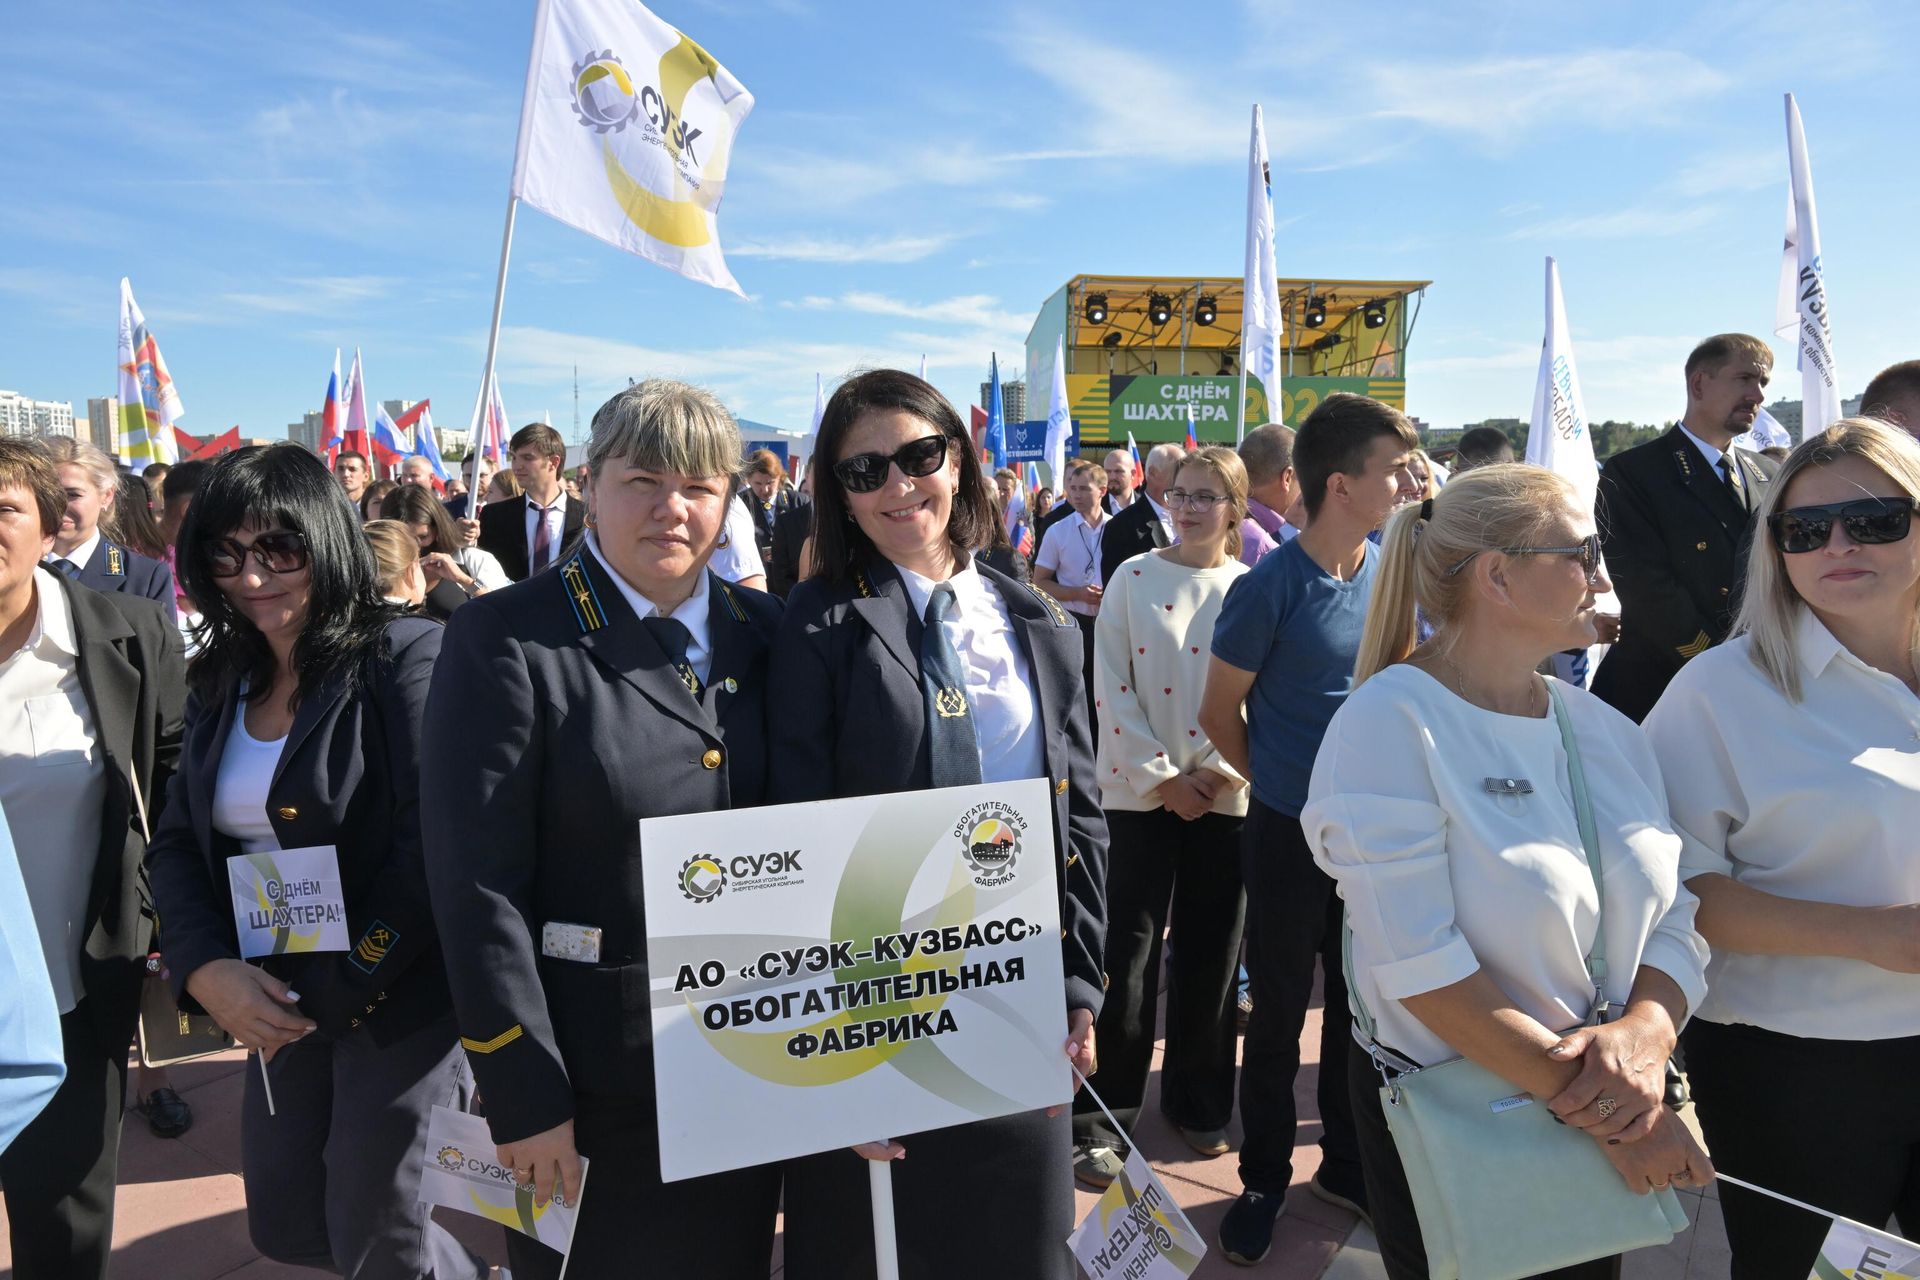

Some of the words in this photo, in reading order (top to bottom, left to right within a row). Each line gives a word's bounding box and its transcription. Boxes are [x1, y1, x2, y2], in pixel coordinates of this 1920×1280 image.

[1804, 321, 1832, 366] компания
[1805, 346, 1833, 388] общество
[1160, 384, 1174, 399] С
[1176, 381, 1230, 401] ДНЁМ
[1244, 387, 1340, 423] 202
[1123, 400, 1229, 421] ШАХТЁРА
[953, 801, 1028, 838] ОБОГАТИТЕЛЬНАЯ
[730, 850, 803, 878] СУЭК
[266, 880, 280, 899] С
[284, 878, 321, 900] ДНЁМ
[731, 879, 762, 887] СИБИРСКАЯ
[732, 882, 777, 892] ЭНЕРГЕТИЧЕСКАЯ
[777, 879, 804, 887] КОМПАНИЯ
[974, 872, 1016, 887] ФАБРИКА
[249, 903, 341, 930] ШАХТЕРА!
[674, 961, 727, 992] АО
[703, 956, 1026, 1031] ОБОГАТИТЕЛЬНАЯ
[786, 1009, 959, 1059] ФАБРИКА
[1090, 1182, 1162, 1279] ШАХТЕРА!
[1154, 1226, 1173, 1250] С
[1122, 1235, 1160, 1280] ДНЁМ
